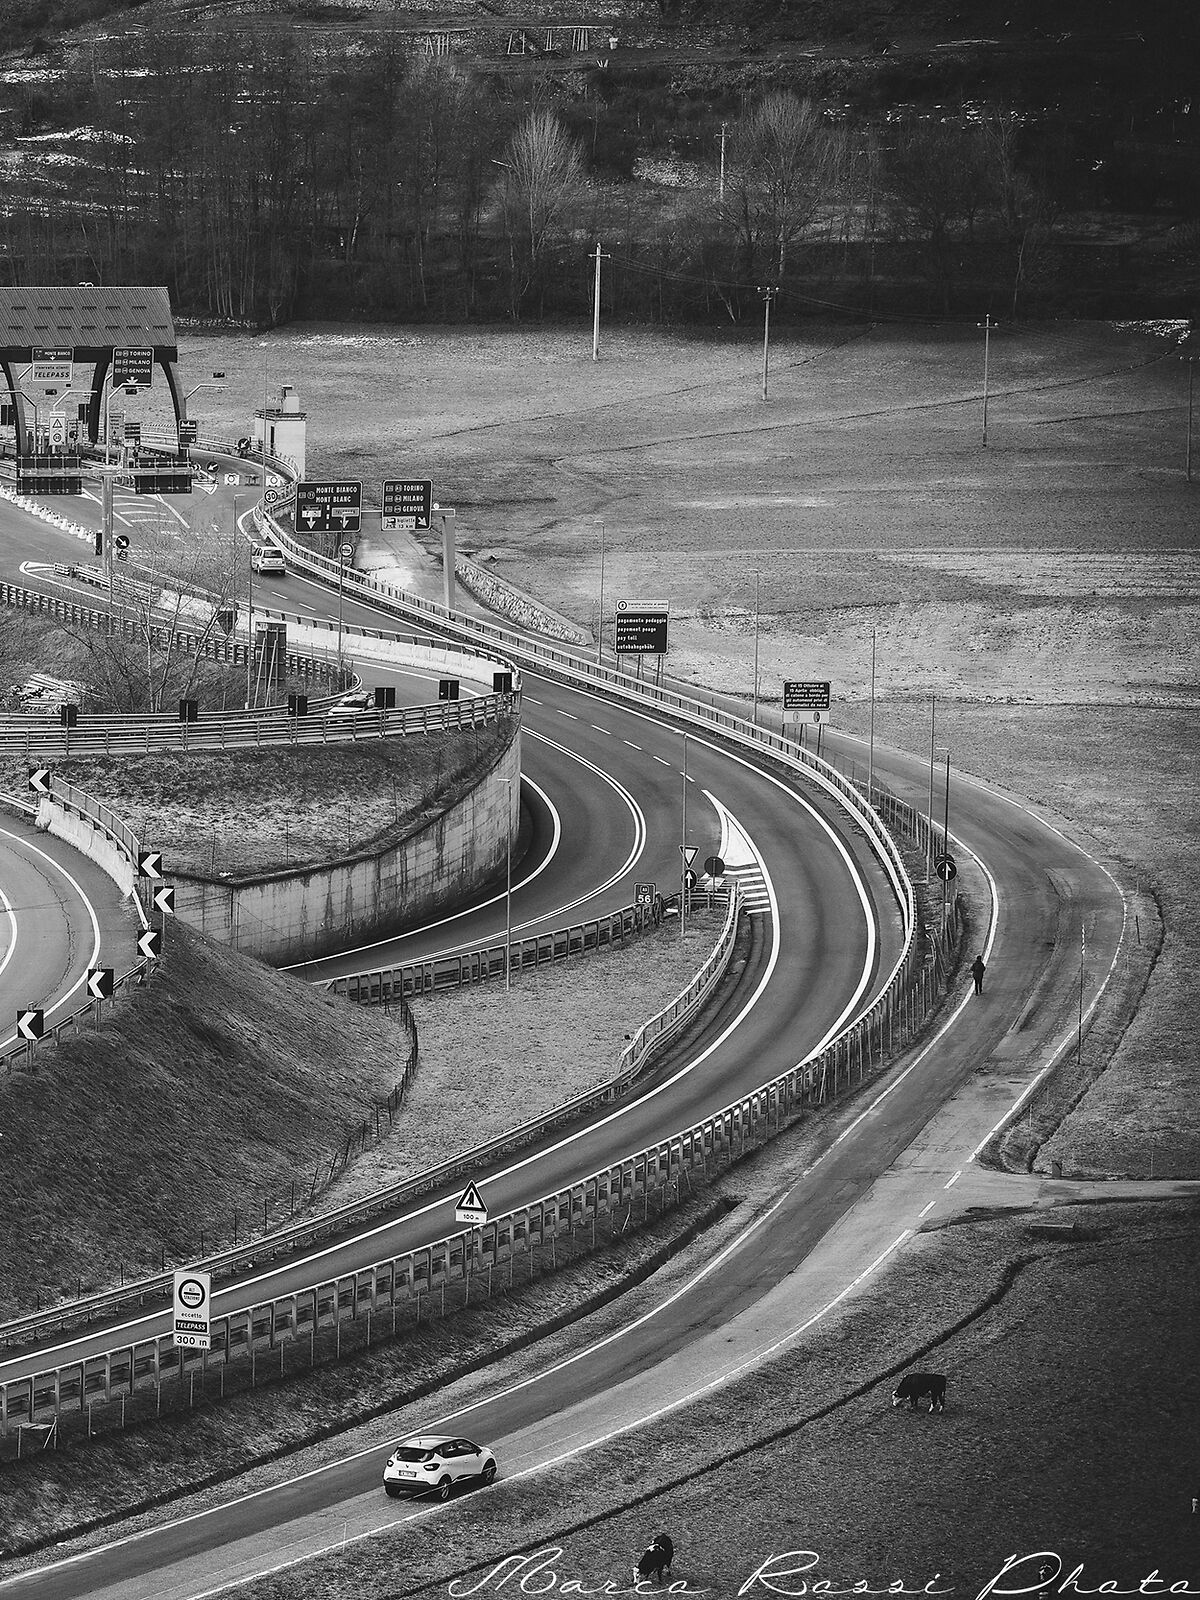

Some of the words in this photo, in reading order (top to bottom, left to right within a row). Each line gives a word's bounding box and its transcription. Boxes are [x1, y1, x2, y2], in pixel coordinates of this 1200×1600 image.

[638, 894, 650, 903] 56
[177, 1322, 206, 1330] TELEPASS
[177, 1336, 195, 1345] 300
